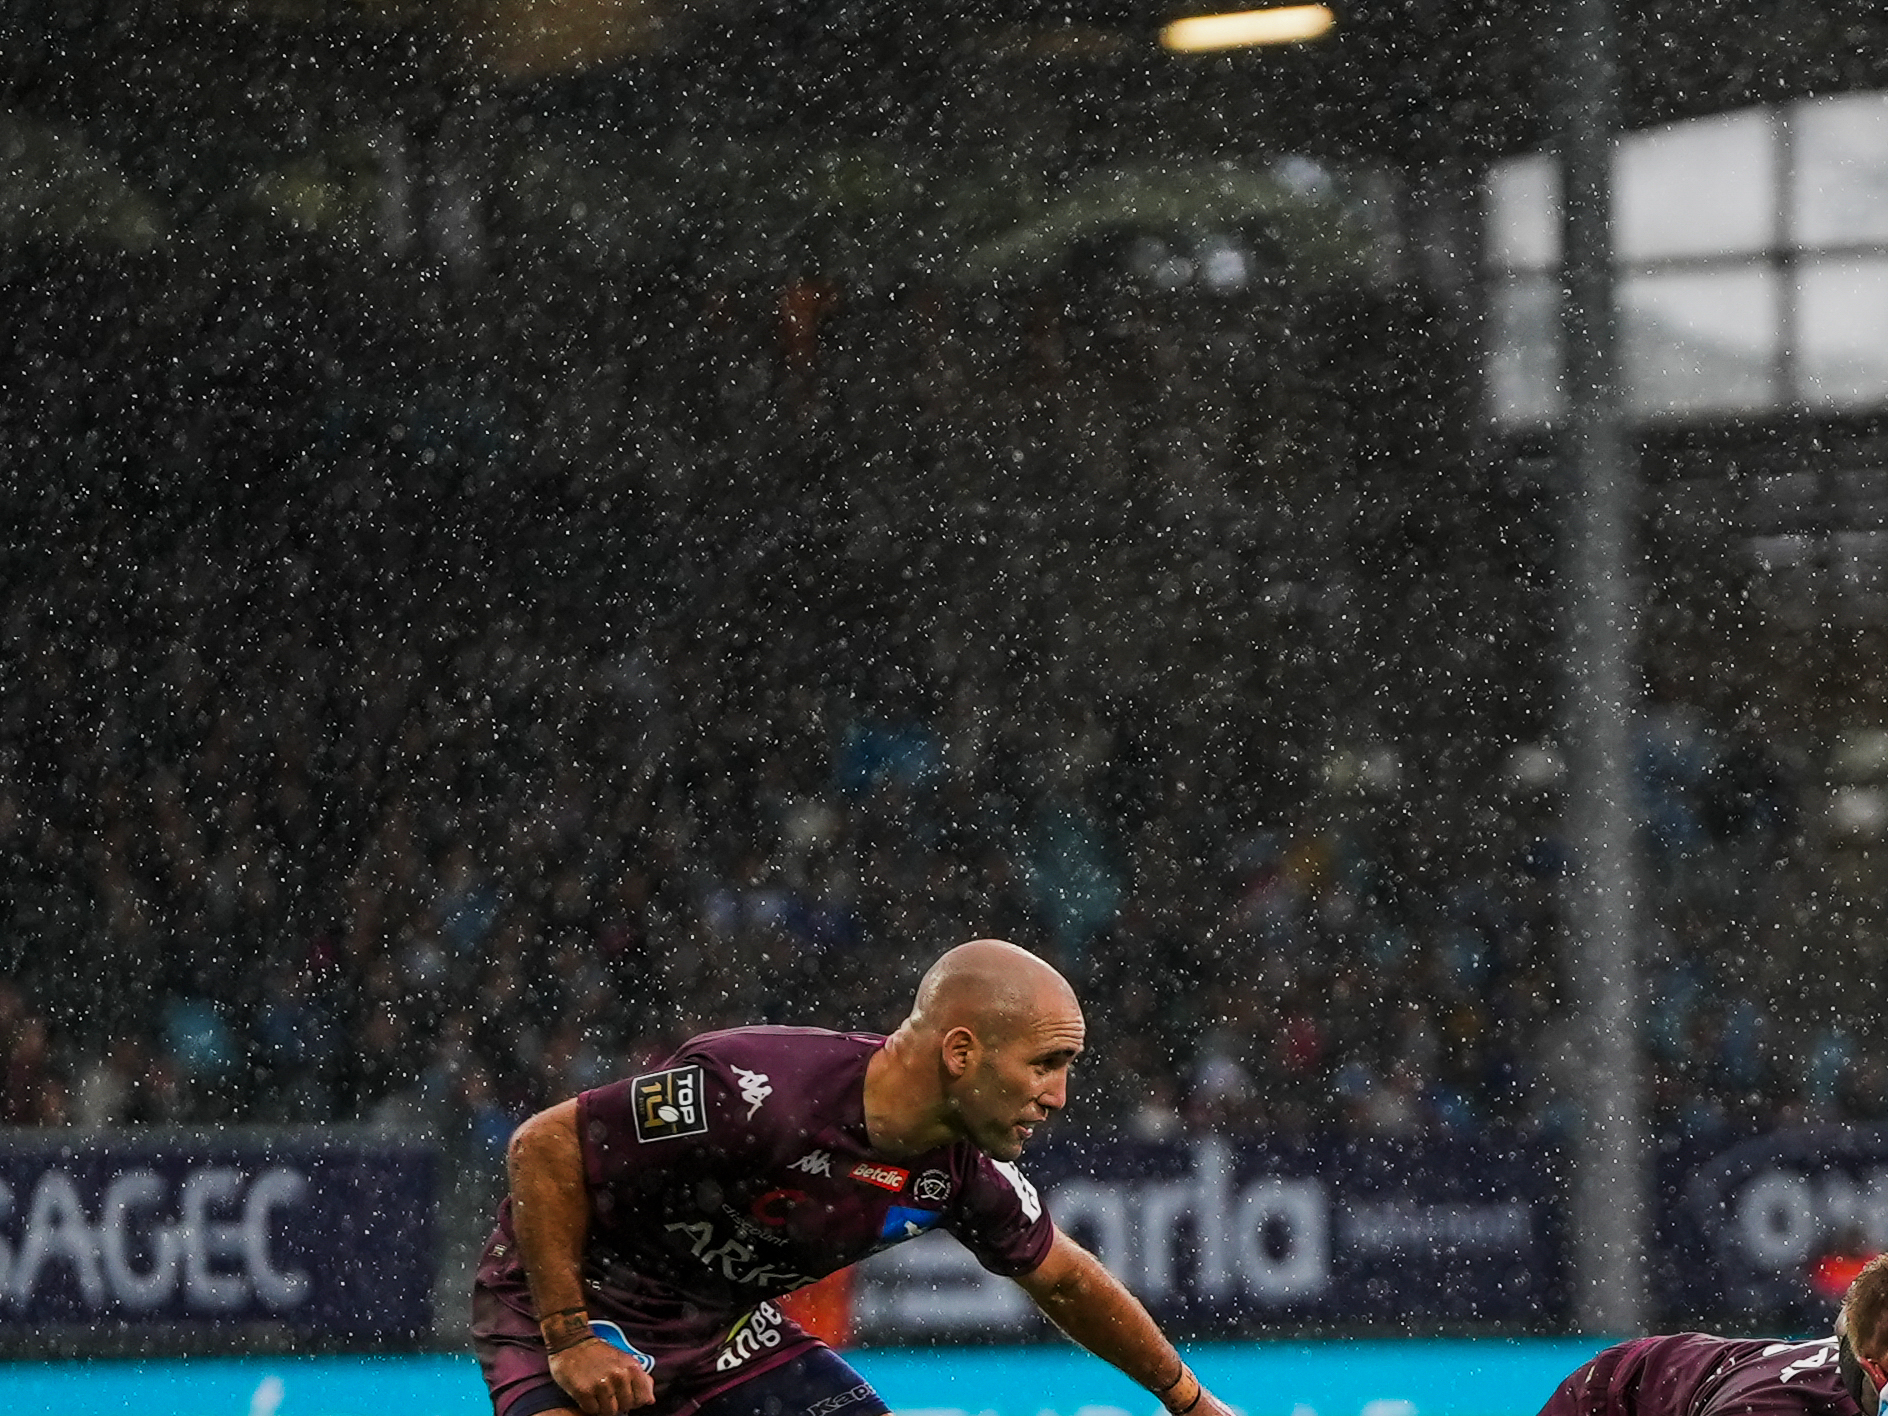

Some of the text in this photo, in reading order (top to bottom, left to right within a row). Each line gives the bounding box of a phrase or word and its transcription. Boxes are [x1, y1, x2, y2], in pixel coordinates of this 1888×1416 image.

[641, 1081, 666, 1129] 14
[676, 1073, 696, 1125] TOP
[853, 1163, 904, 1188] Betclic
